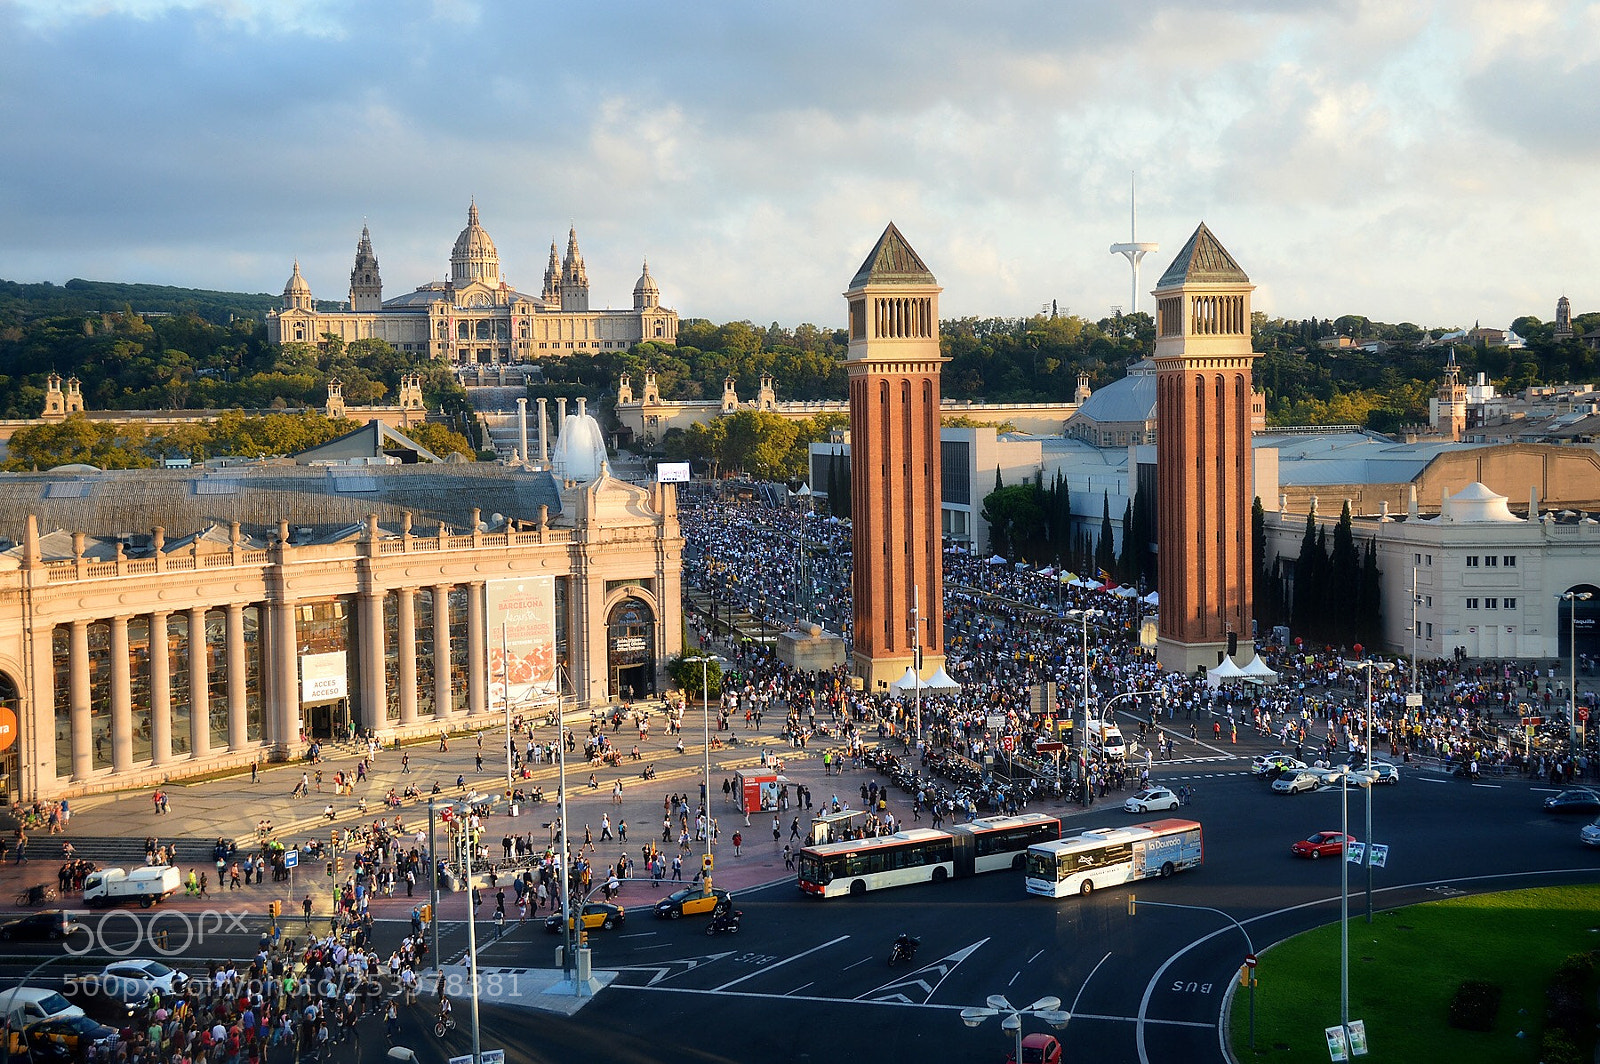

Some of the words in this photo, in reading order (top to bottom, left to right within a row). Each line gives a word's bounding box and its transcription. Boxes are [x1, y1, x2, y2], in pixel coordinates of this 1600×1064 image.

[498, 600, 543, 611] BARCELONA
[311, 688, 339, 698] ACCESO
[1171, 980, 1213, 994] BUS
